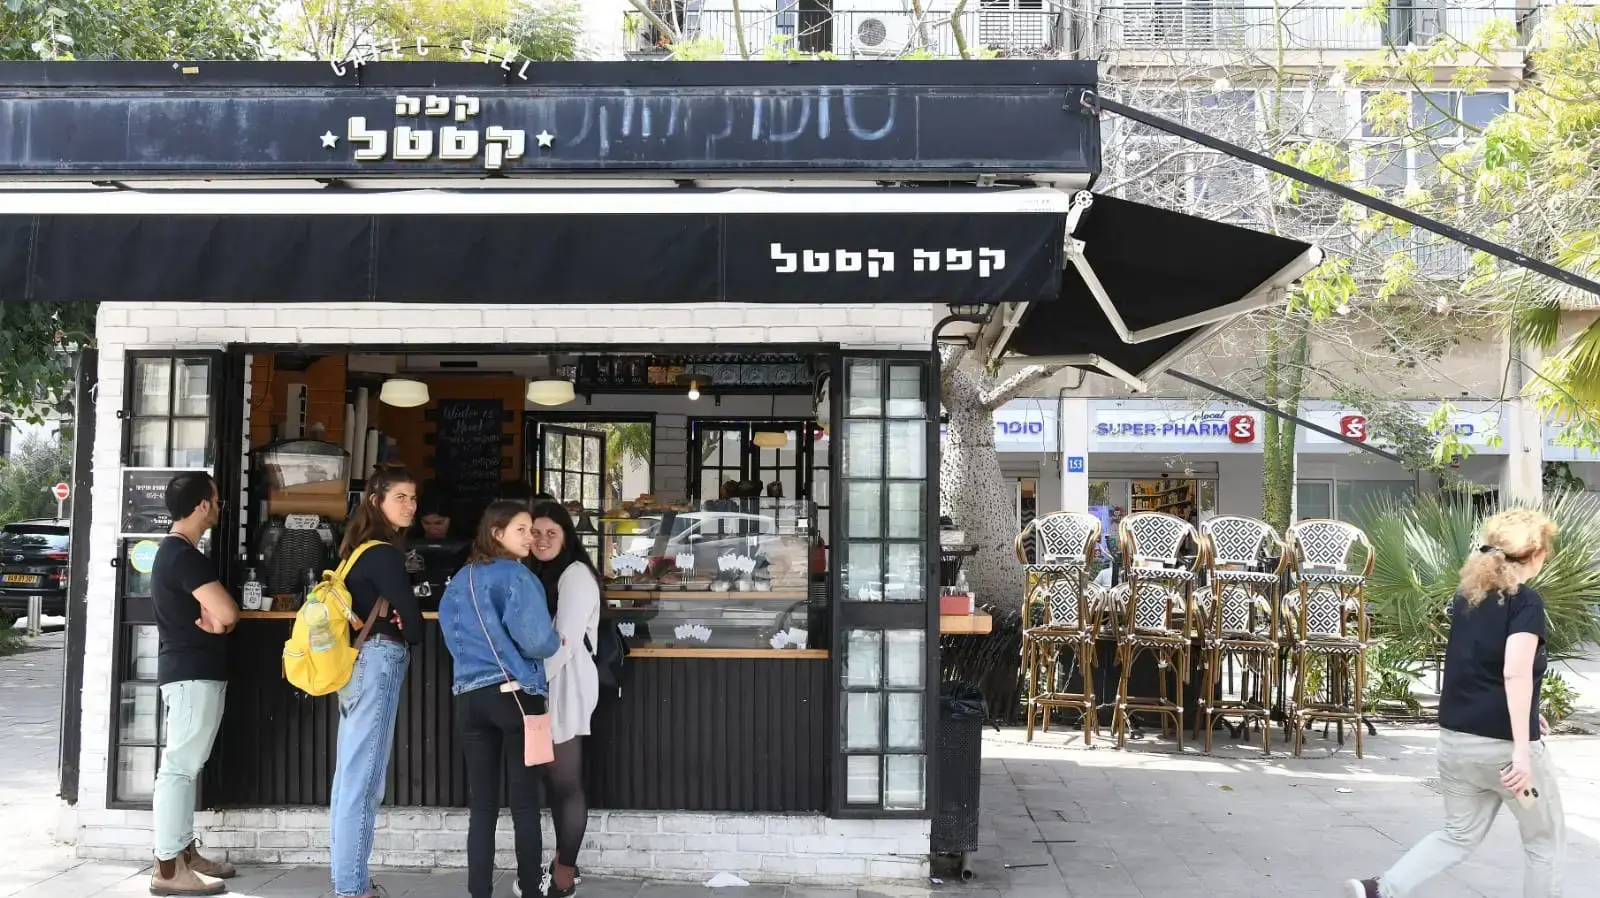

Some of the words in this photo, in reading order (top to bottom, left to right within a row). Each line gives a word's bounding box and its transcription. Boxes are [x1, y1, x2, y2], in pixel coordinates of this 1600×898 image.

[395, 94, 480, 122] קפה
[347, 116, 526, 170] קסטל
[770, 242, 895, 278] קסטל
[913, 247, 1006, 278] קפה
[996, 420, 1043, 435] סופר
[1096, 420, 1229, 438] SUPER-PHARM
[1069, 458, 1083, 470] 153
